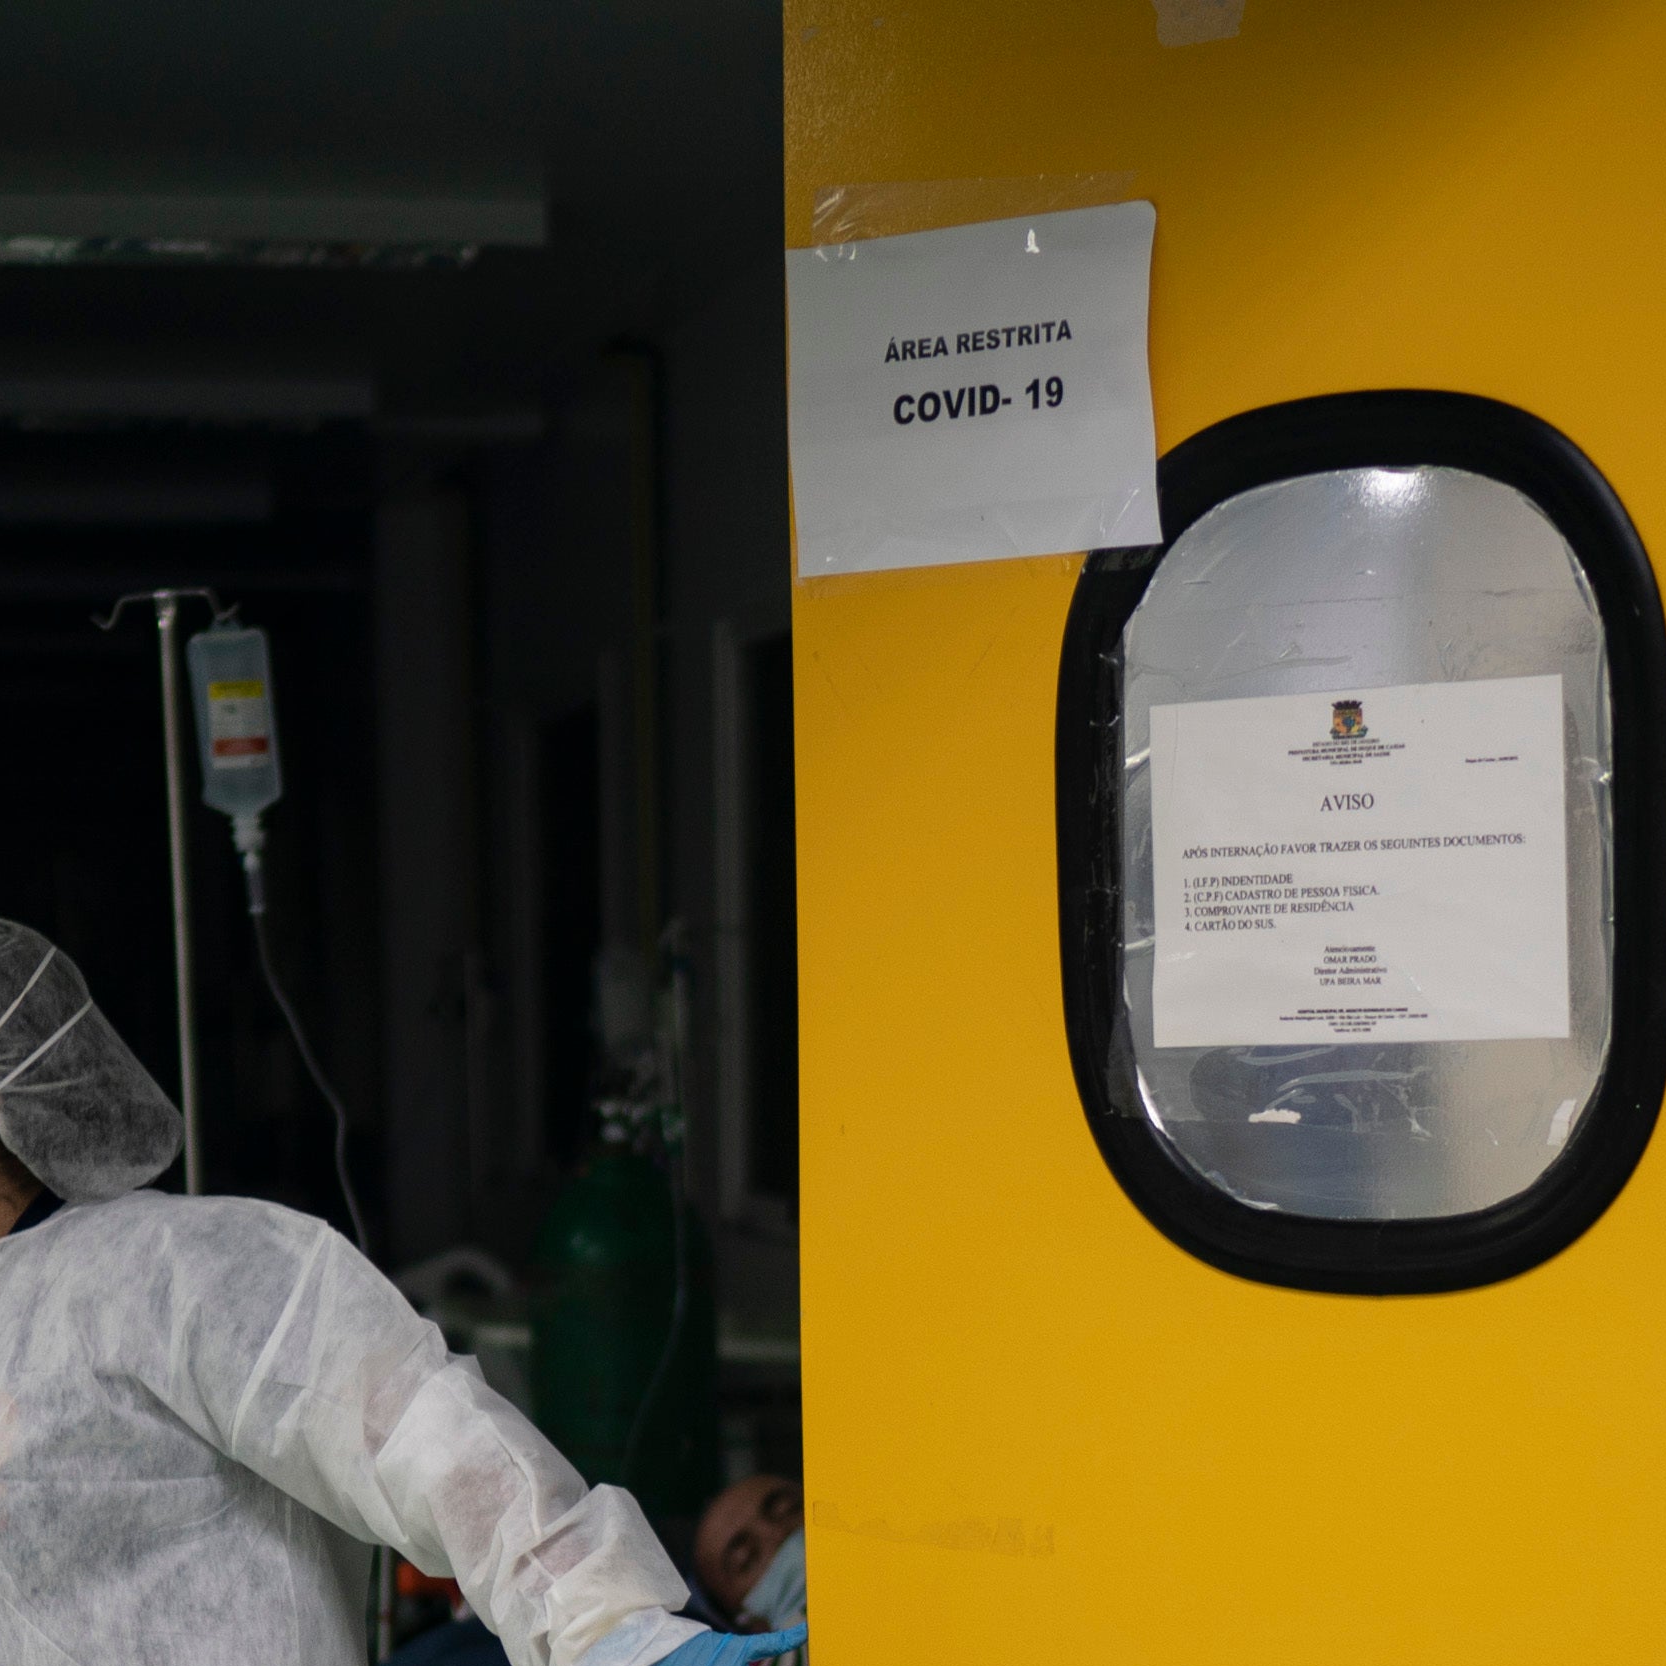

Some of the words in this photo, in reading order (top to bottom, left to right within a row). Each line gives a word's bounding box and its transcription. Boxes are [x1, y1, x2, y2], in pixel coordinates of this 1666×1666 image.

[884, 336, 949, 363] ÁREA
[955, 319, 1073, 355] RESTRITA
[1024, 376, 1064, 410] 19
[1320, 793, 1375, 812] AVISO
[1182, 845, 1208, 859] APÓS
[1210, 843, 1279, 858] INTERNAÇÃO
[1280, 842, 1317, 854] FAVOR
[1319, 840, 1361, 853] TRAZER
[1363, 840, 1378, 850] OS
[1380, 836, 1441, 850] SEGUINTES
[1443, 833, 1526, 847] DOCUMENTOS:
[1183, 878, 1192, 889] 1.
[1221, 873, 1294, 887] INDENTIDADE
[1184, 892, 1192, 903] 2.
[1225, 888, 1282, 901] CADASTRO
[1284, 888, 1298, 899] DE
[1301, 886, 1340, 898] PESSOA
[1194, 904, 1271, 917] COMPROVANTE
[1273, 903, 1288, 914] DE
[1290, 899, 1355, 914] RESIDÊNCIA
[1194, 918, 1236, 932] CARTÃO
[1238, 919, 1253, 930] DO
[1254, 918, 1277, 930] SUS.
[1323, 955, 1347, 964] OMAR
[1349, 954, 1377, 963] PRADO
[1320, 978, 1335, 986] UPA
[1337, 977, 1361, 986] BEIRA
[1363, 976, 1381, 985] MAR
